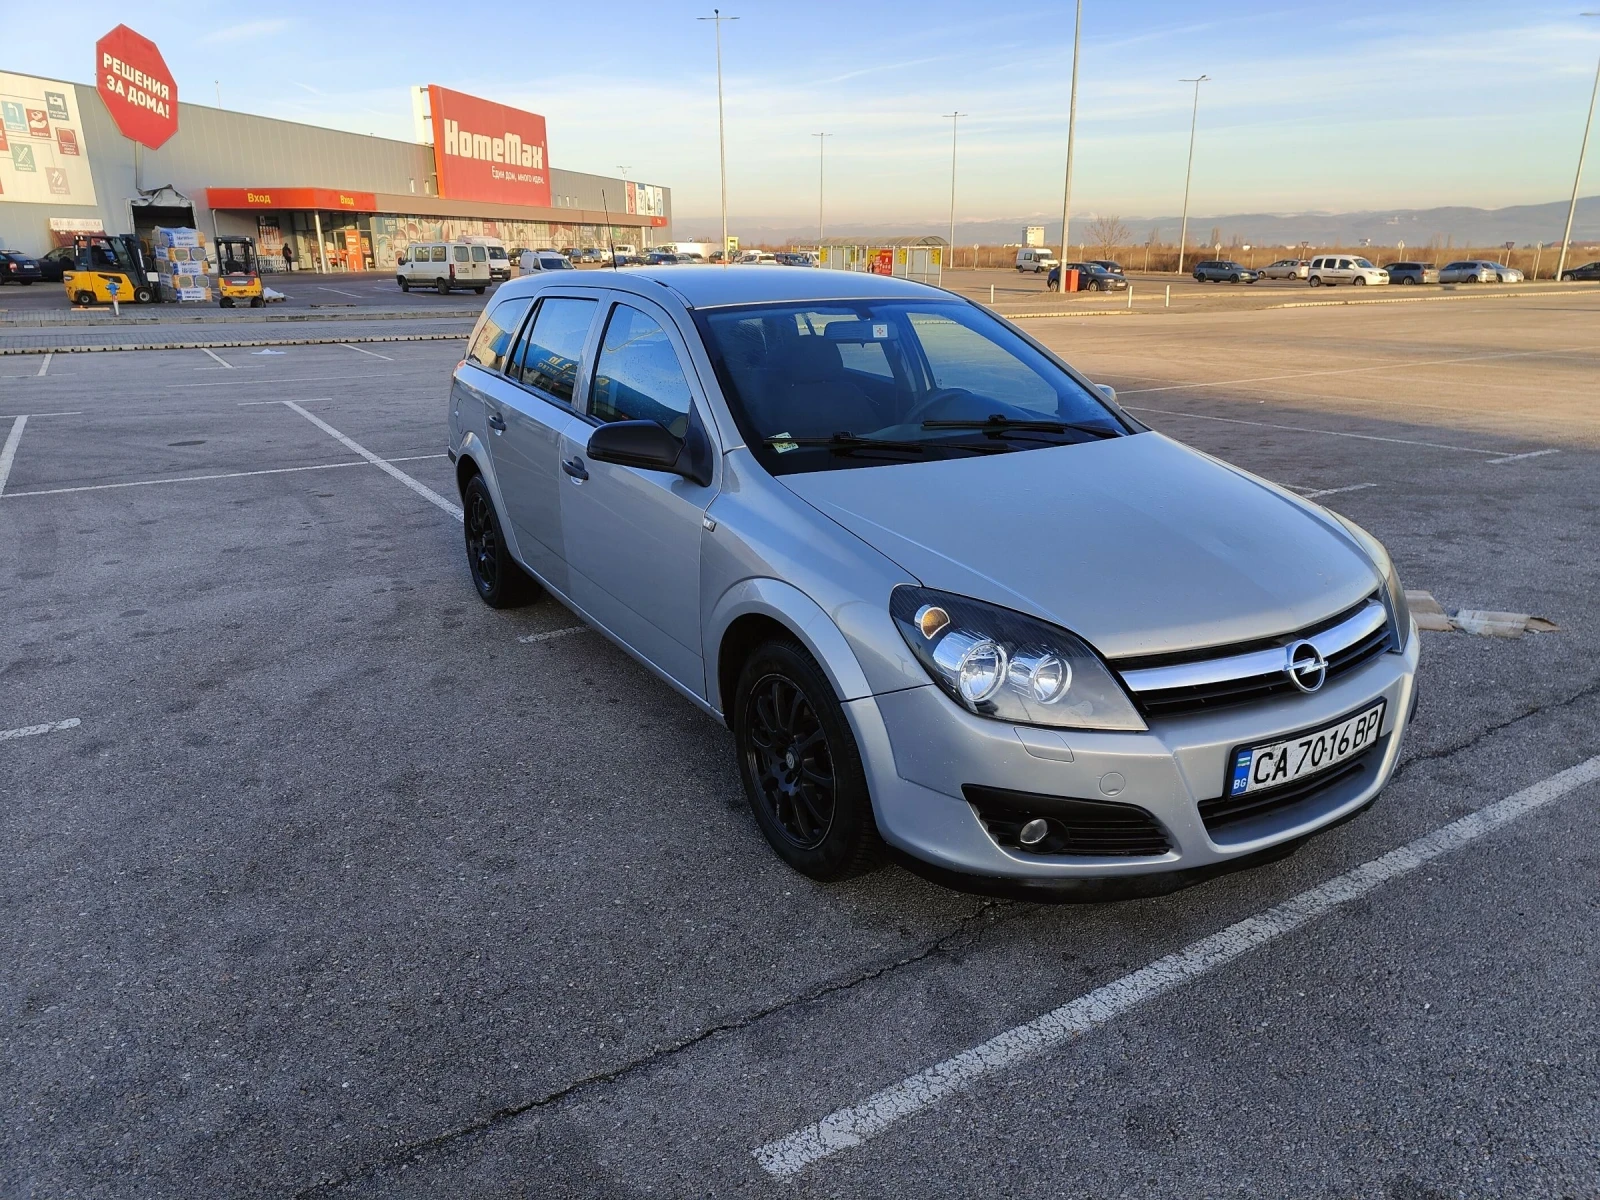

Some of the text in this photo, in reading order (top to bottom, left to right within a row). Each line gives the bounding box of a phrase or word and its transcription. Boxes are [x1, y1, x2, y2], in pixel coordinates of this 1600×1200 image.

[103, 52, 169, 100] РЕШЕНИЯ
[106, 74, 170, 119] ЗА ДОМА!
[444, 118, 543, 170] HomeMax
[491, 165, 505, 180] Един
[247, 193, 271, 204] Вход
[340, 195, 355, 206] Вход
[1253, 747, 1288, 785] CA
[1352, 709, 1379, 750] BP
[1233, 777, 1247, 790] BG
